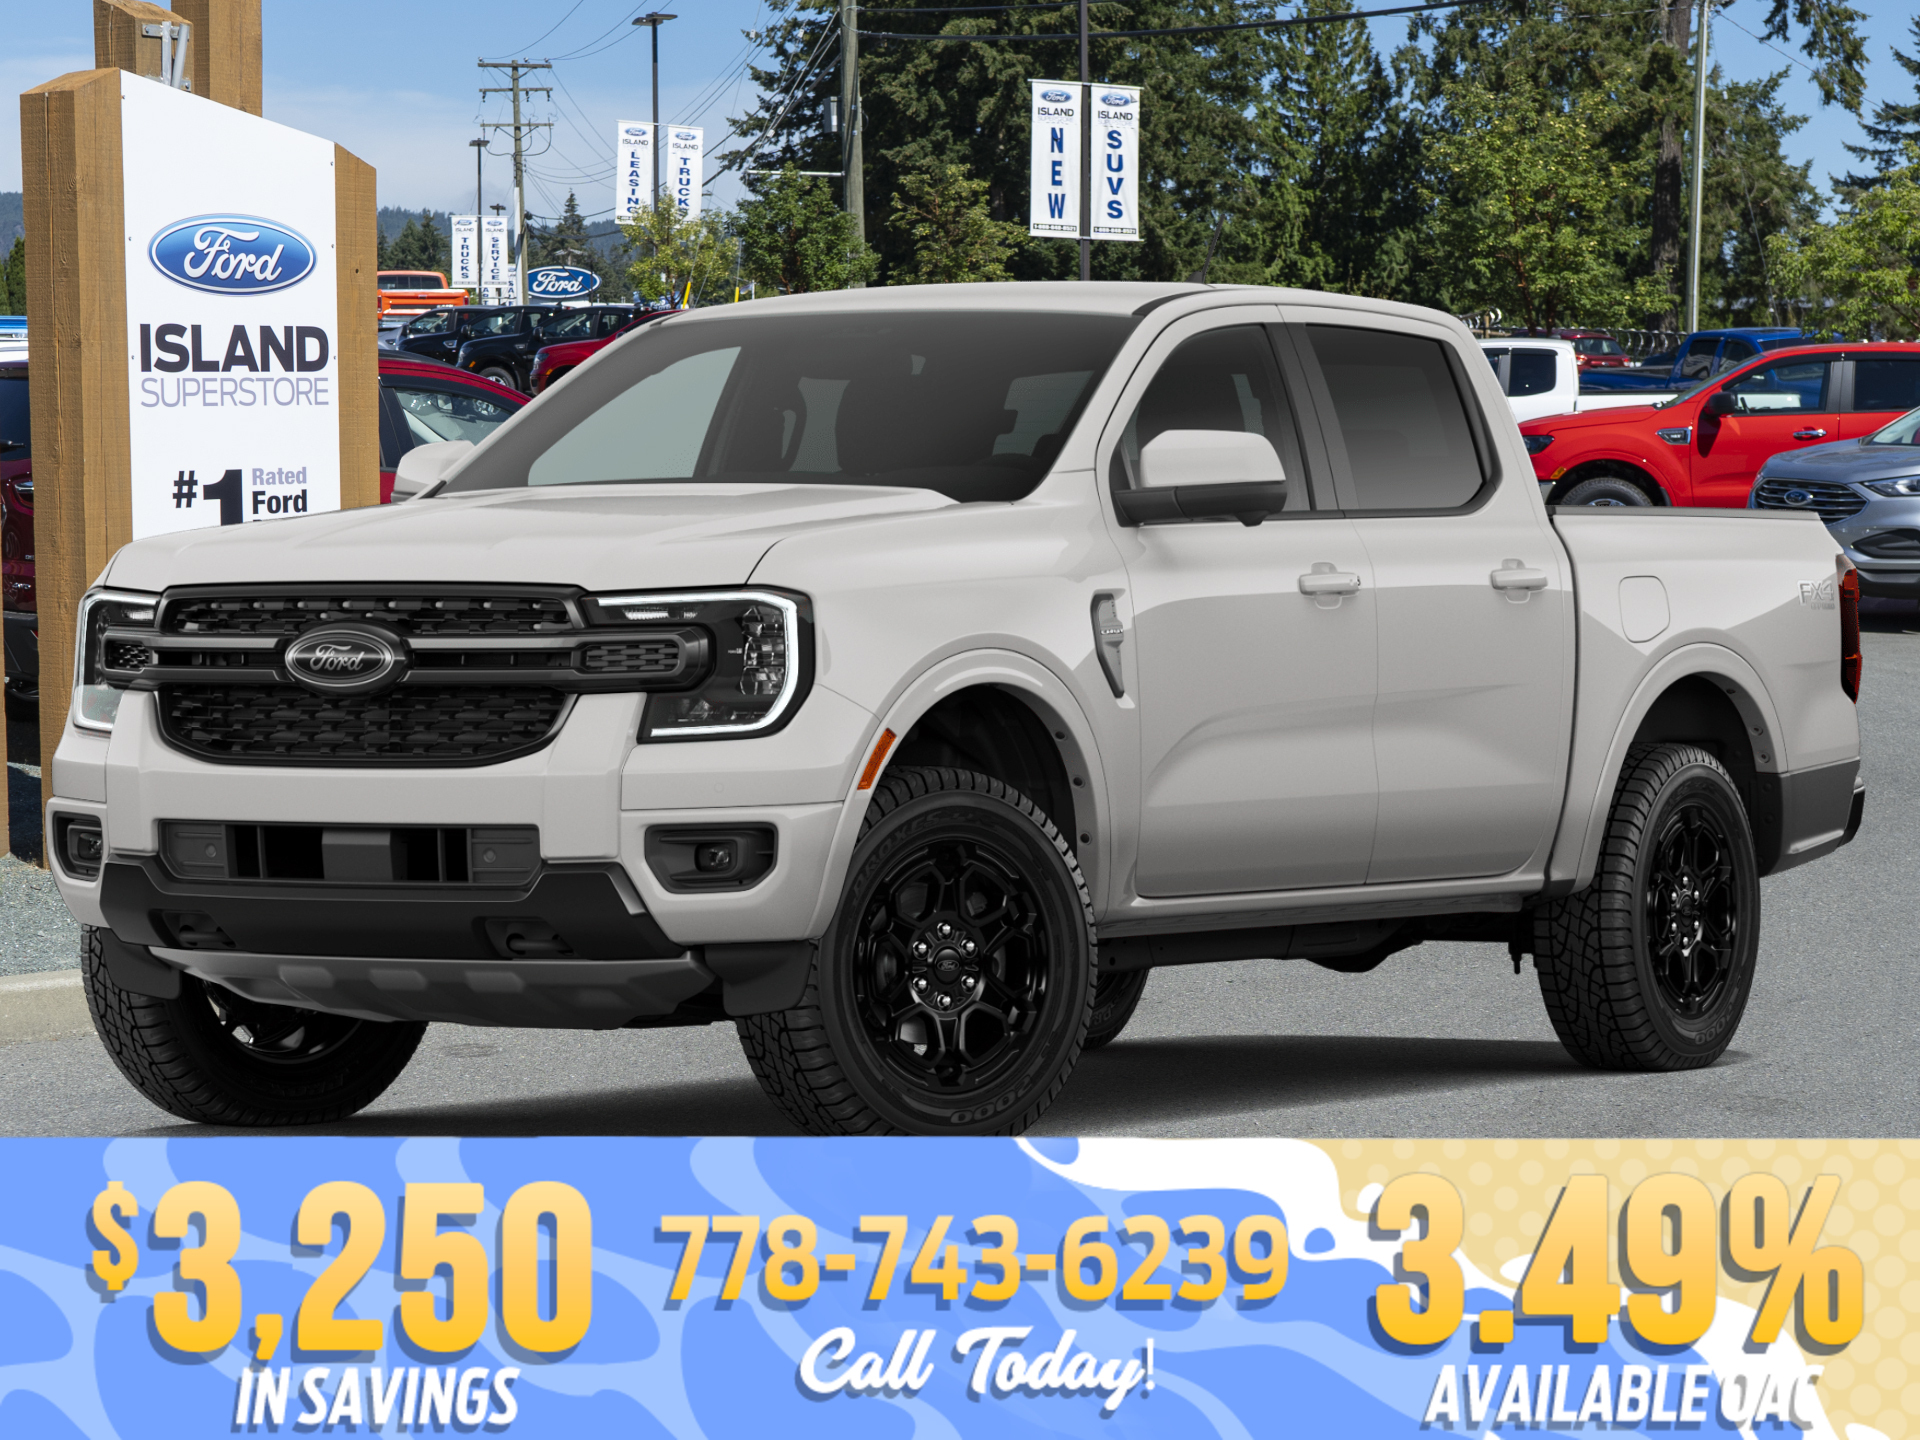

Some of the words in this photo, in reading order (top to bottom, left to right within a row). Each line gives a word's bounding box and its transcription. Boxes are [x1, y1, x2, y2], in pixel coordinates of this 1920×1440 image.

[1046, 92, 1067, 102] Ford
[1105, 96, 1126, 106] Ford
[1037, 107, 1074, 117] ISLAND
[1097, 111, 1134, 121] ISLAND
[622, 138, 649, 146] ISLAND
[672, 142, 699, 150] ISLAND
[1048, 127, 1066, 219] NEW
[1106, 129, 1125, 219] SUVS
[183, 226, 285, 282] Ford
[461, 236, 470, 279] TRUCKS
[490, 236, 500, 281] SERVICE
[532, 270, 584, 292] Ford
[139, 322, 330, 374] ISLAND
[140, 377, 330, 408] SUPERSTORE
[251, 466, 308, 486] Rated
[172, 468, 244, 527] #1
[251, 488, 308, 515] Ford
[1797, 579, 1834, 606] FX4
[309, 643, 366, 671] Ford
